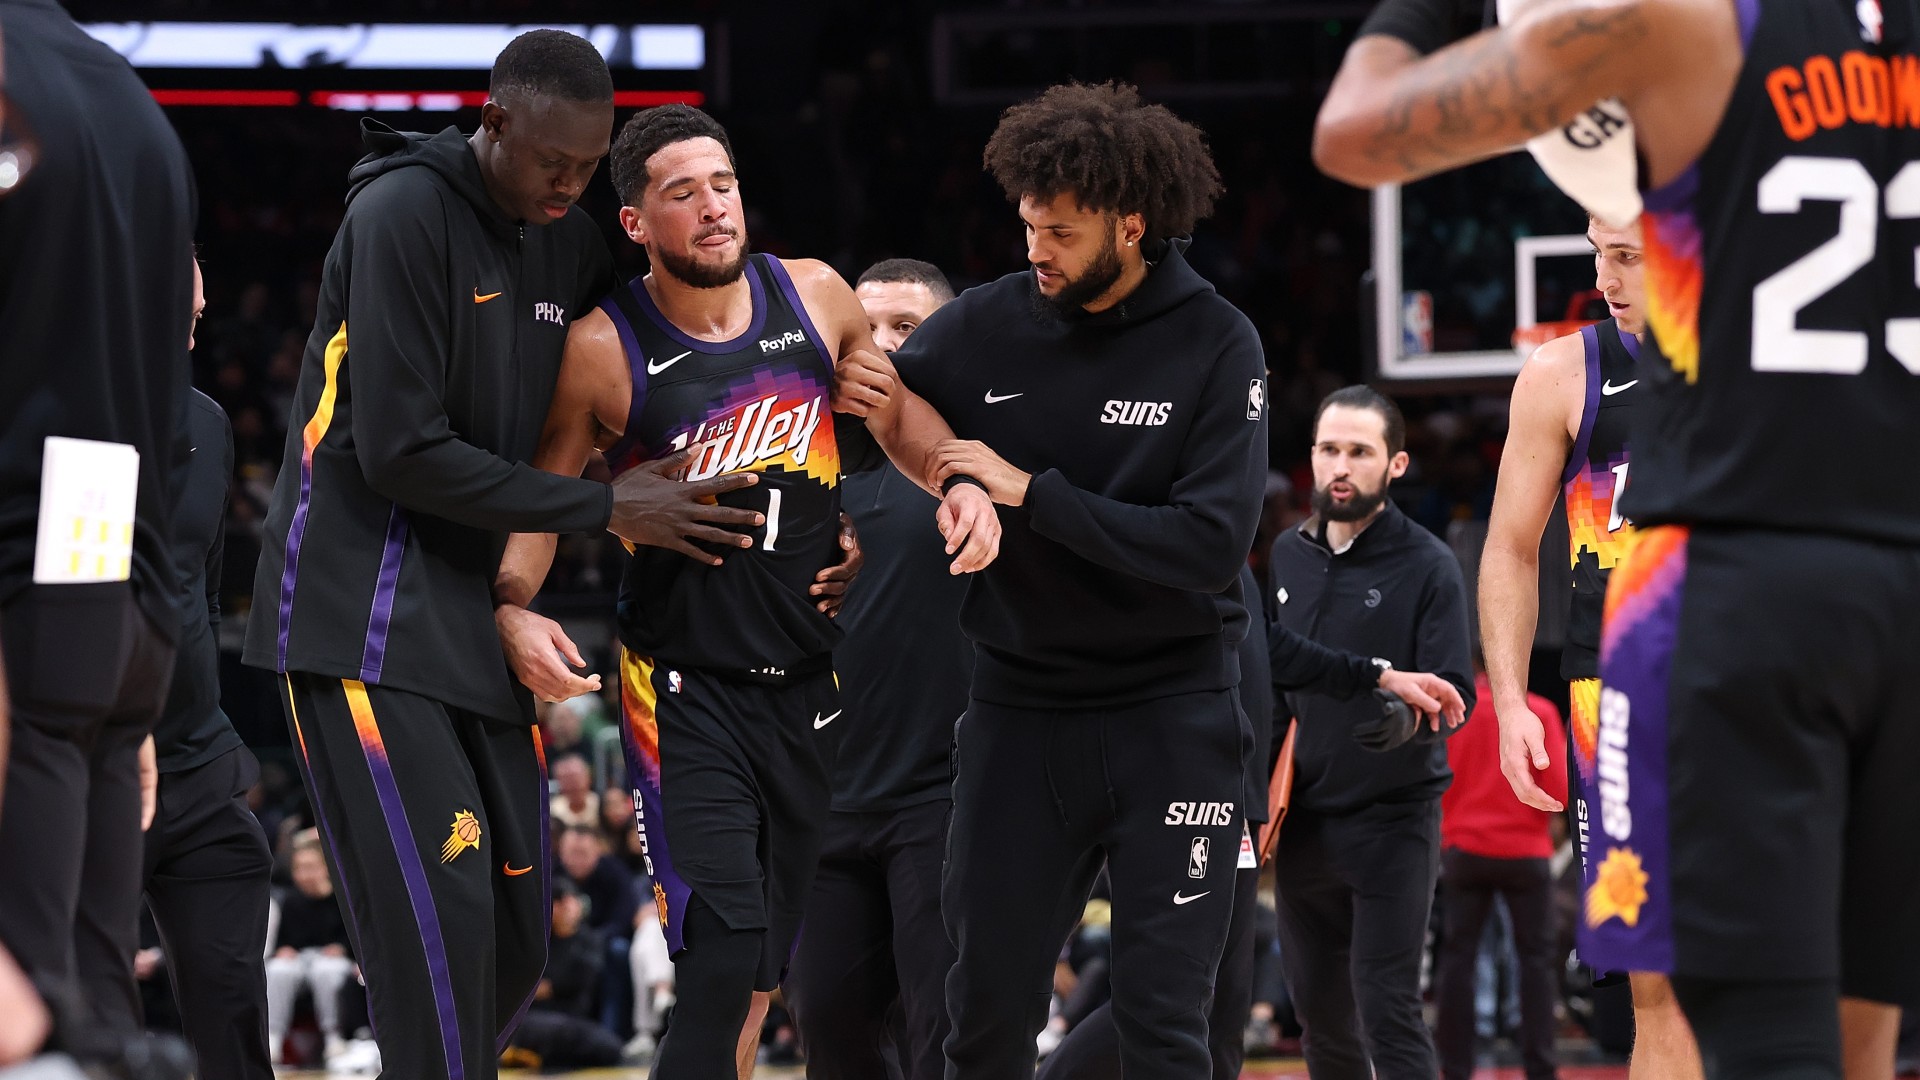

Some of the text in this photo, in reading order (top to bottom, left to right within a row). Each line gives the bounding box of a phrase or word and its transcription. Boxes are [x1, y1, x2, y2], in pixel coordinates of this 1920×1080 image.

[534, 302, 565, 326] PHX
[759, 329, 806, 352] PayPal
[1100, 399, 1173, 426] SUNS
[707, 416, 737, 441] THE
[763, 488, 782, 552] 1
[1164, 802, 1235, 826] SUNS
